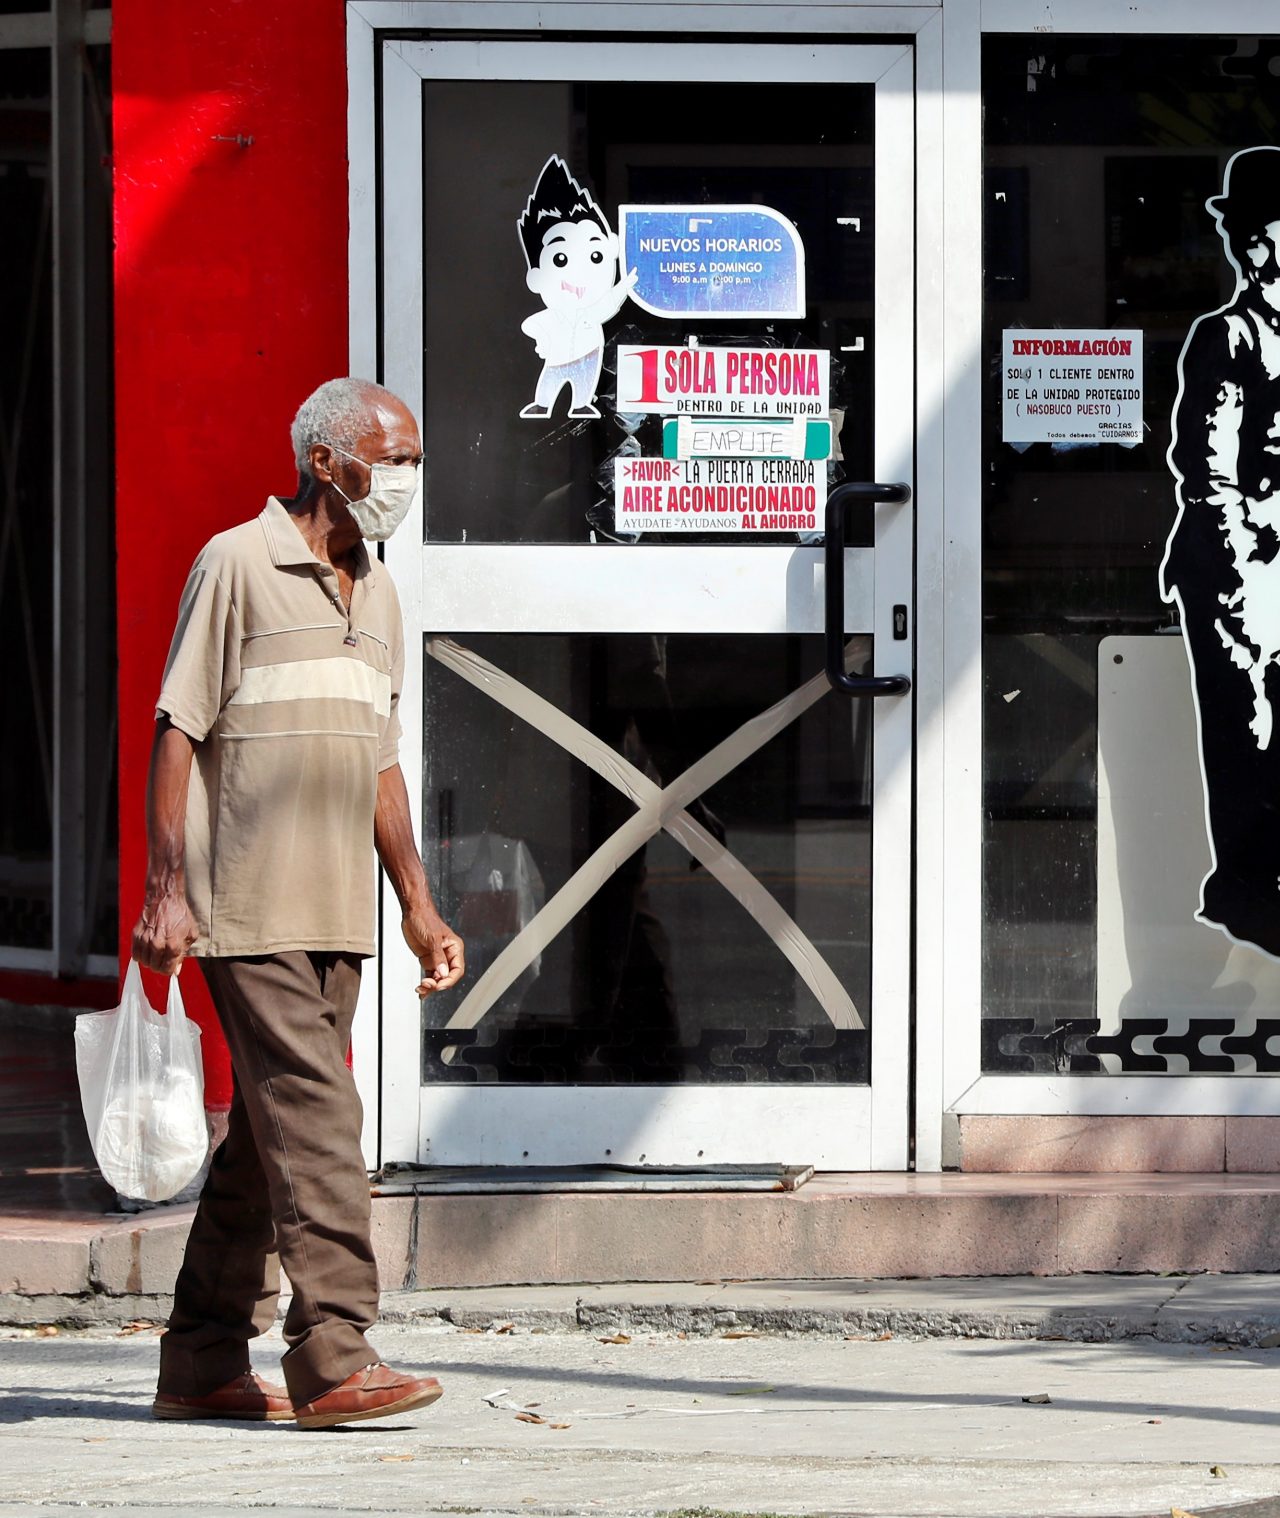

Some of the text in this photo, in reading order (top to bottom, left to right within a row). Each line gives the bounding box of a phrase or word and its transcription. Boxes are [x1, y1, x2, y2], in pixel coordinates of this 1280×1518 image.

[640, 239, 783, 252] NUEVOS HORARIOS
[660, 262, 763, 273] LUNES A DOMINGO
[672, 276, 690, 284] 9:00
[713, 275, 734, 285] :00
[1012, 336, 1132, 356] INFORMACIÓN
[624, 349, 673, 404] 1
[664, 350, 820, 396] SOLA PERSONA
[1038, 368, 1043, 380] 1
[1049, 368, 1092, 380] CLIENTE
[1097, 368, 1135, 380] DENTRO
[1007, 389, 1140, 400] DE LA UNIDAD PROTEGIDO
[677, 399, 822, 414] DENTRO DE LA UNIDAD
[1026, 404, 1072, 415] NASOBUCO
[1077, 404, 1111, 415] PUESTO
[1098, 422, 1132, 430] GRACIAS
[692, 430, 784, 453] EMPUJE
[685, 460, 700, 483] LA
[708, 460, 754, 484] PUERTA
[761, 460, 815, 484] CERRADA
[622, 486, 816, 512] AIRE ACONDICIONADO
[623, 518, 672, 529] AYUDATE
[741, 514, 757, 529] AL
[760, 514, 816, 529] AHORRO
